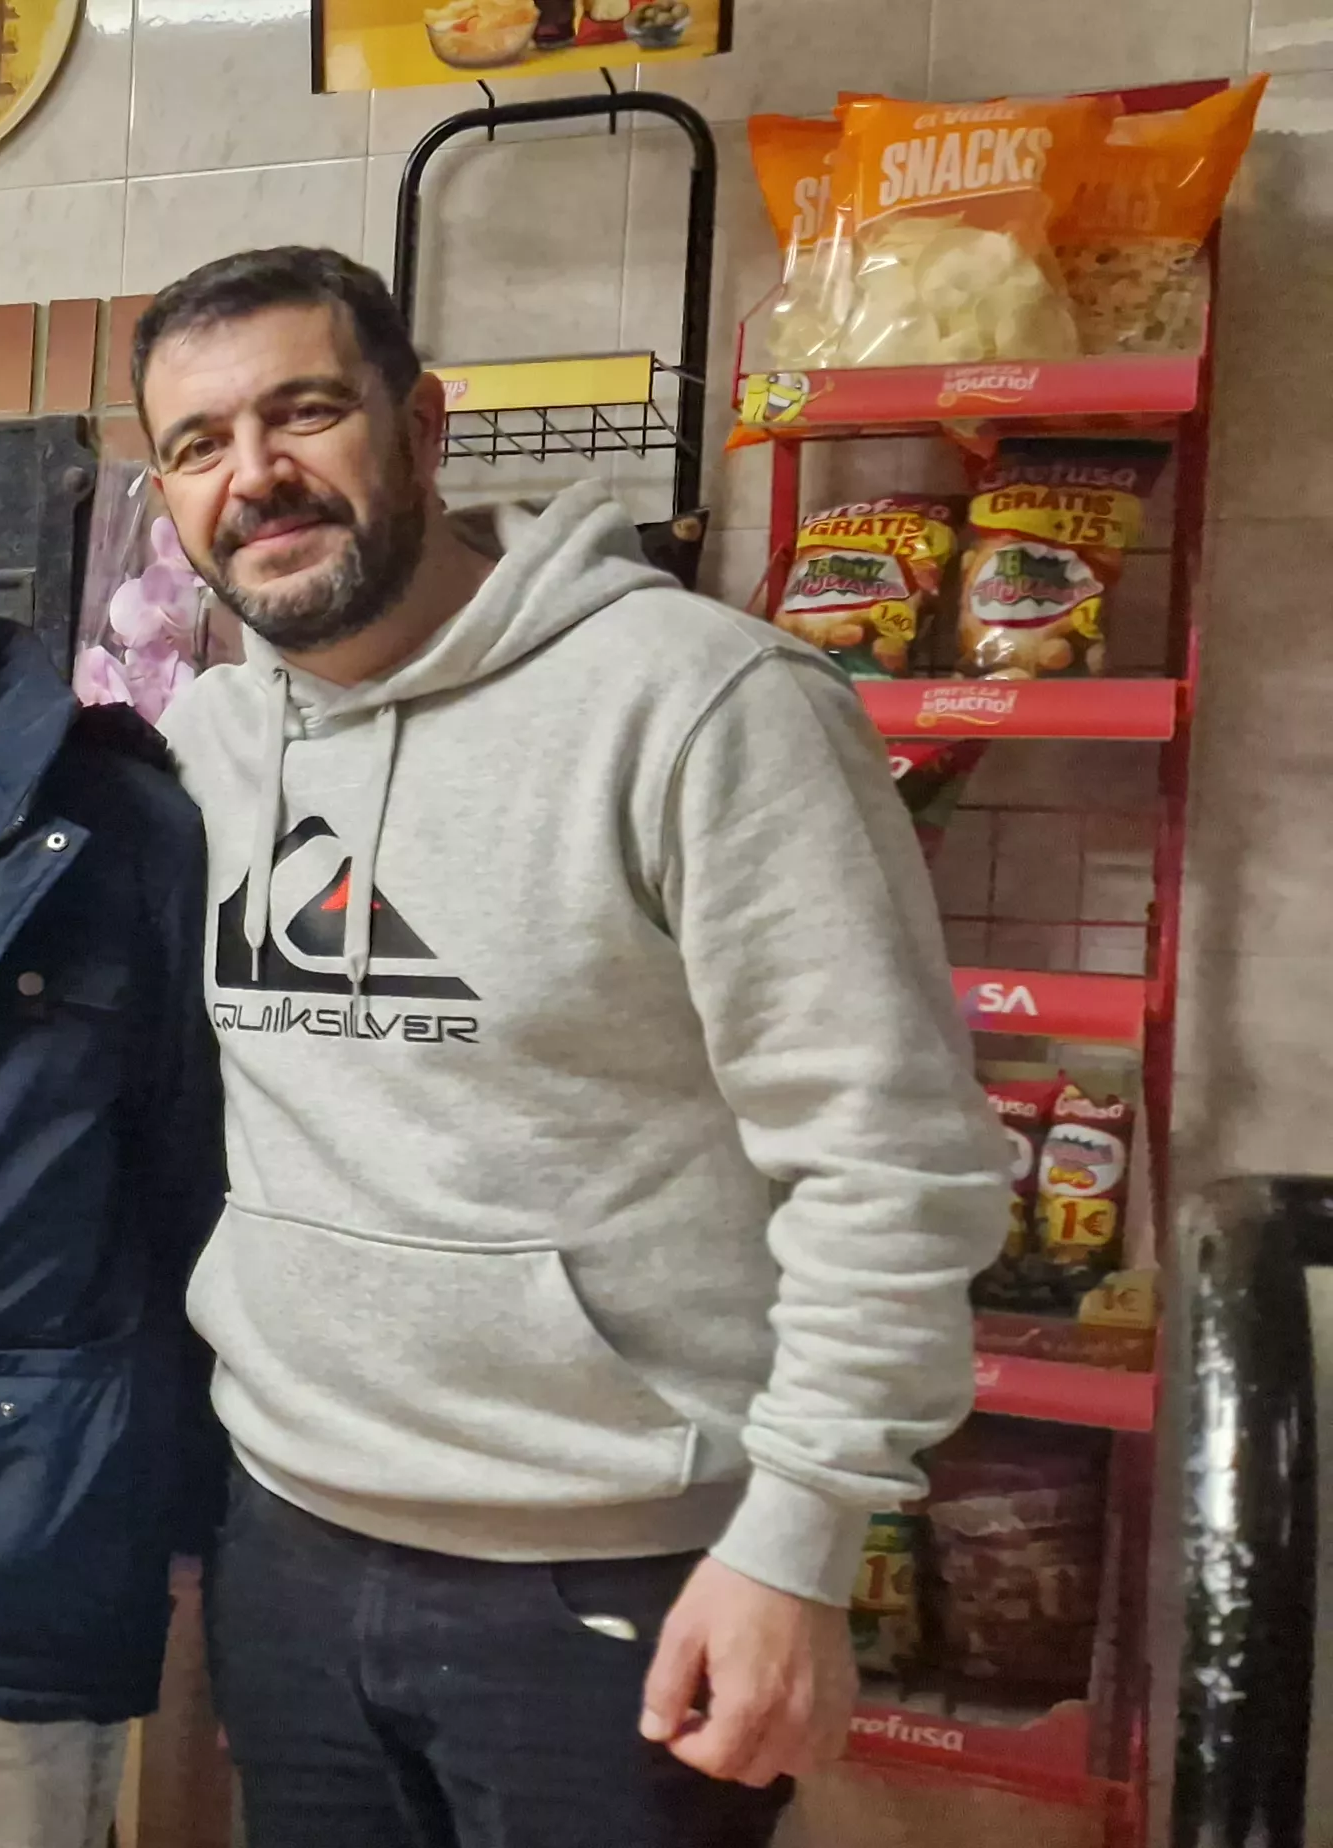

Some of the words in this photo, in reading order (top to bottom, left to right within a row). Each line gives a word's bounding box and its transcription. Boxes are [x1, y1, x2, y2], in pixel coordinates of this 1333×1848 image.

[879, 126, 1054, 206] SNACKS
[989, 491, 1115, 517] GRATIS
[808, 516, 927, 537] GRATIS
[213, 996, 481, 1044] QUIKSILVER
[850, 1714, 965, 1752] refusa
